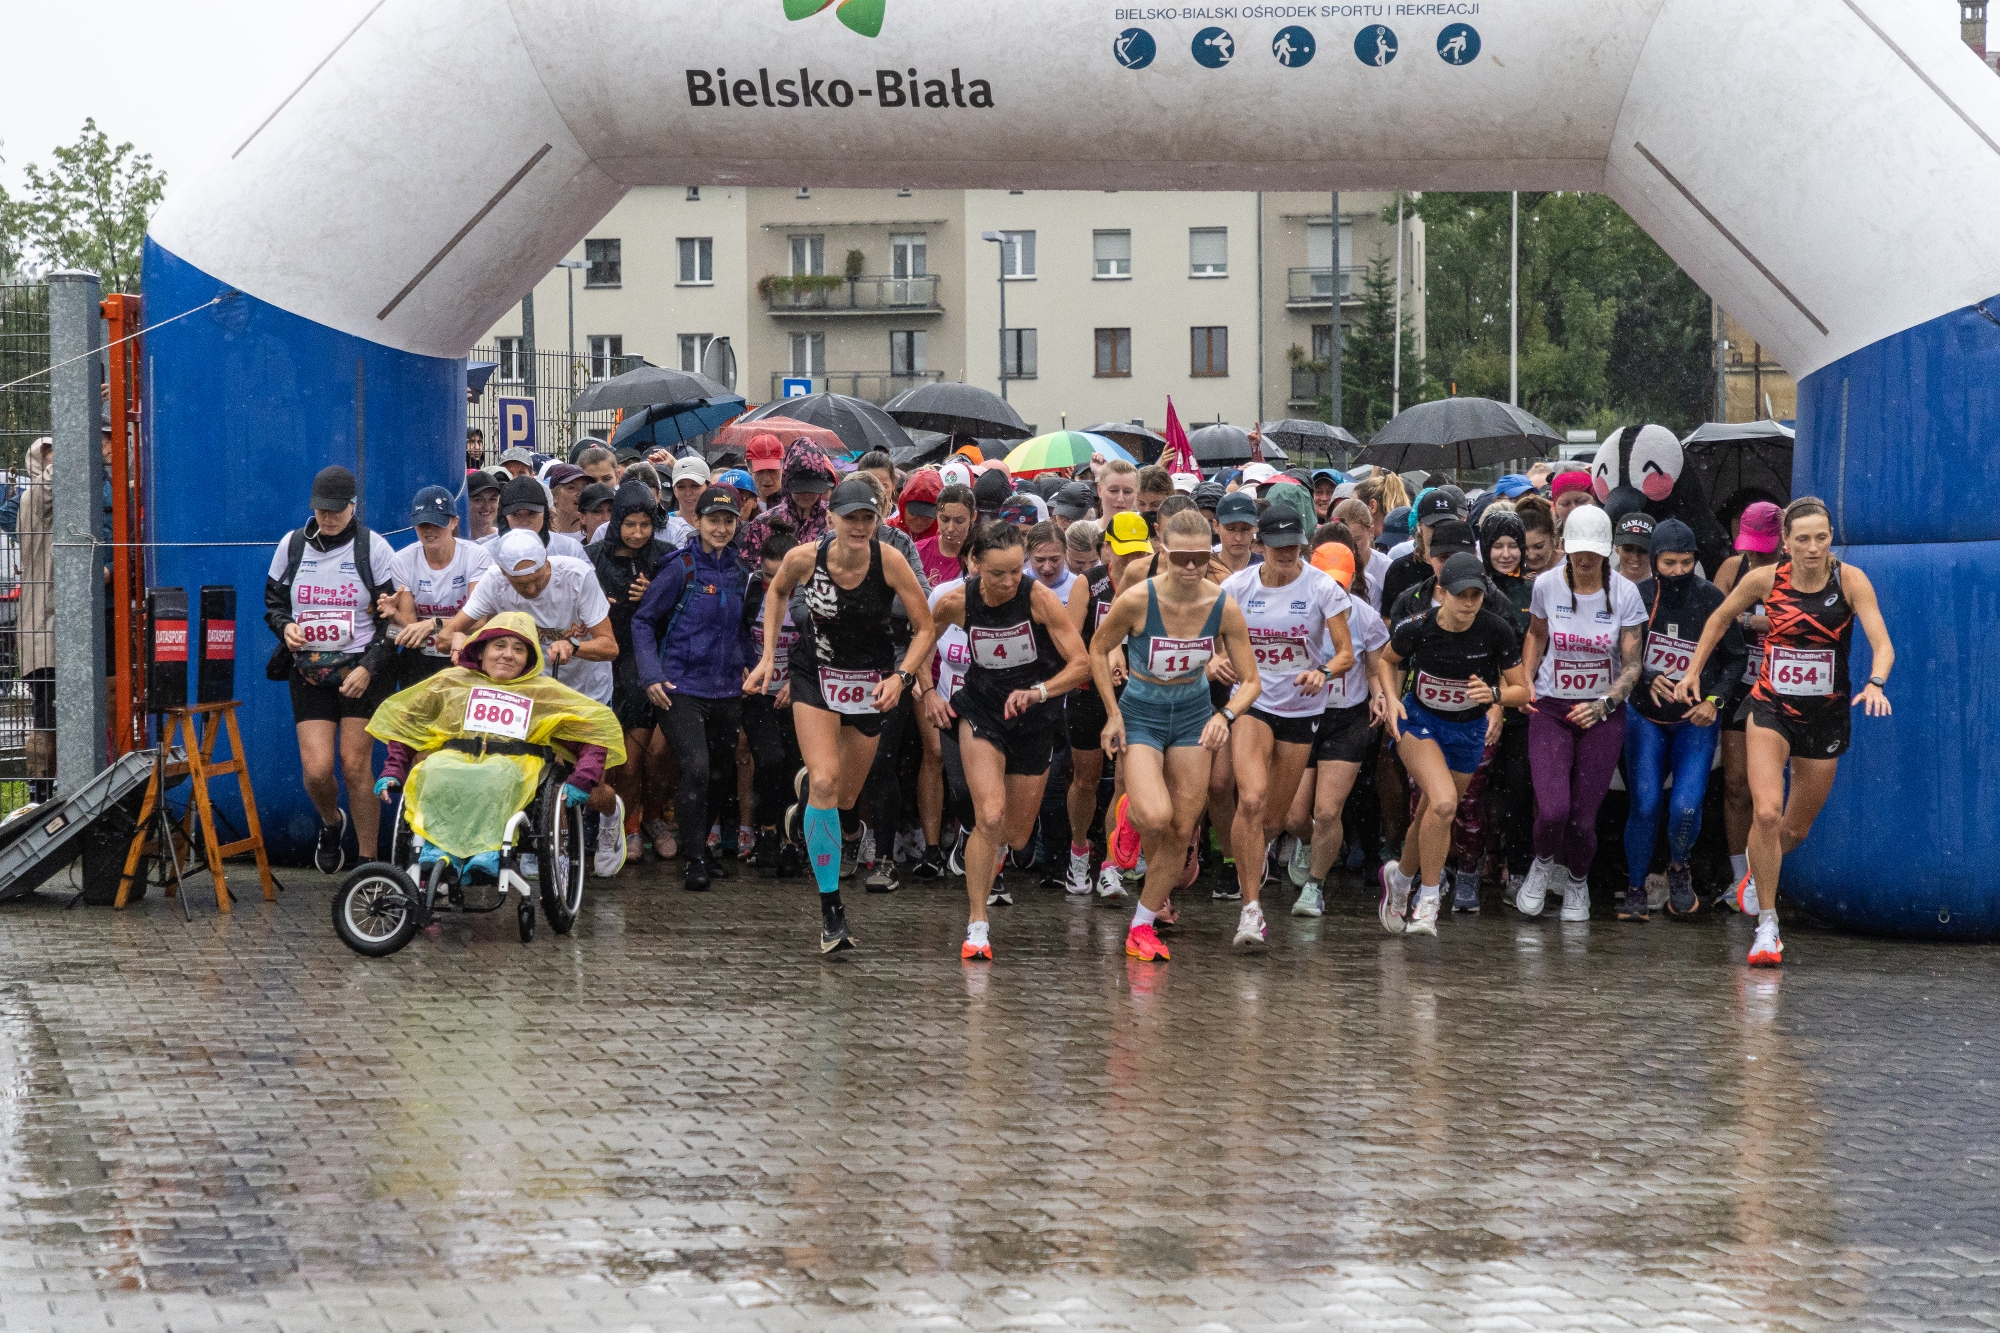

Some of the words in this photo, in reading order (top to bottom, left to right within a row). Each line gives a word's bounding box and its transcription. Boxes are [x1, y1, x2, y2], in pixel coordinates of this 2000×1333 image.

[1115, 8, 1237, 20] BIELSKO-BIALSKI
[1242, 5, 1316, 18] OŚRODEK
[1321, 5, 1382, 17] SPORTU
[1387, 5, 1391, 16] I
[1396, 3, 1479, 16] REKREACJI
[685, 67, 995, 108] Bielsko-Biała
[507, 404, 528, 450] P
[1622, 520, 1652, 533] CANADA
[300, 588, 309, 597] 5
[313, 586, 337, 597] Bieg
[313, 597, 358, 607] KoBBiet
[156, 630, 187, 644] DATASPORT
[207, 629, 234, 642] DATASPORT
[304, 625, 340, 642] 883
[1555, 635, 1564, 645] 5
[1568, 634, 1592, 646] Bieg
[950, 646, 960, 656] 5
[993, 643, 1007, 660] 4
[1254, 646, 1294, 665] 954
[1569, 645, 1610, 655] KoBBiet
[1165, 655, 1190, 672] 11
[1651, 649, 1690, 672] 790
[1560, 673, 1599, 690] 907
[1778, 665, 1818, 685] 654
[827, 684, 864, 703] 768
[1424, 687, 1466, 704] 955
[473, 703, 514, 725] 880
